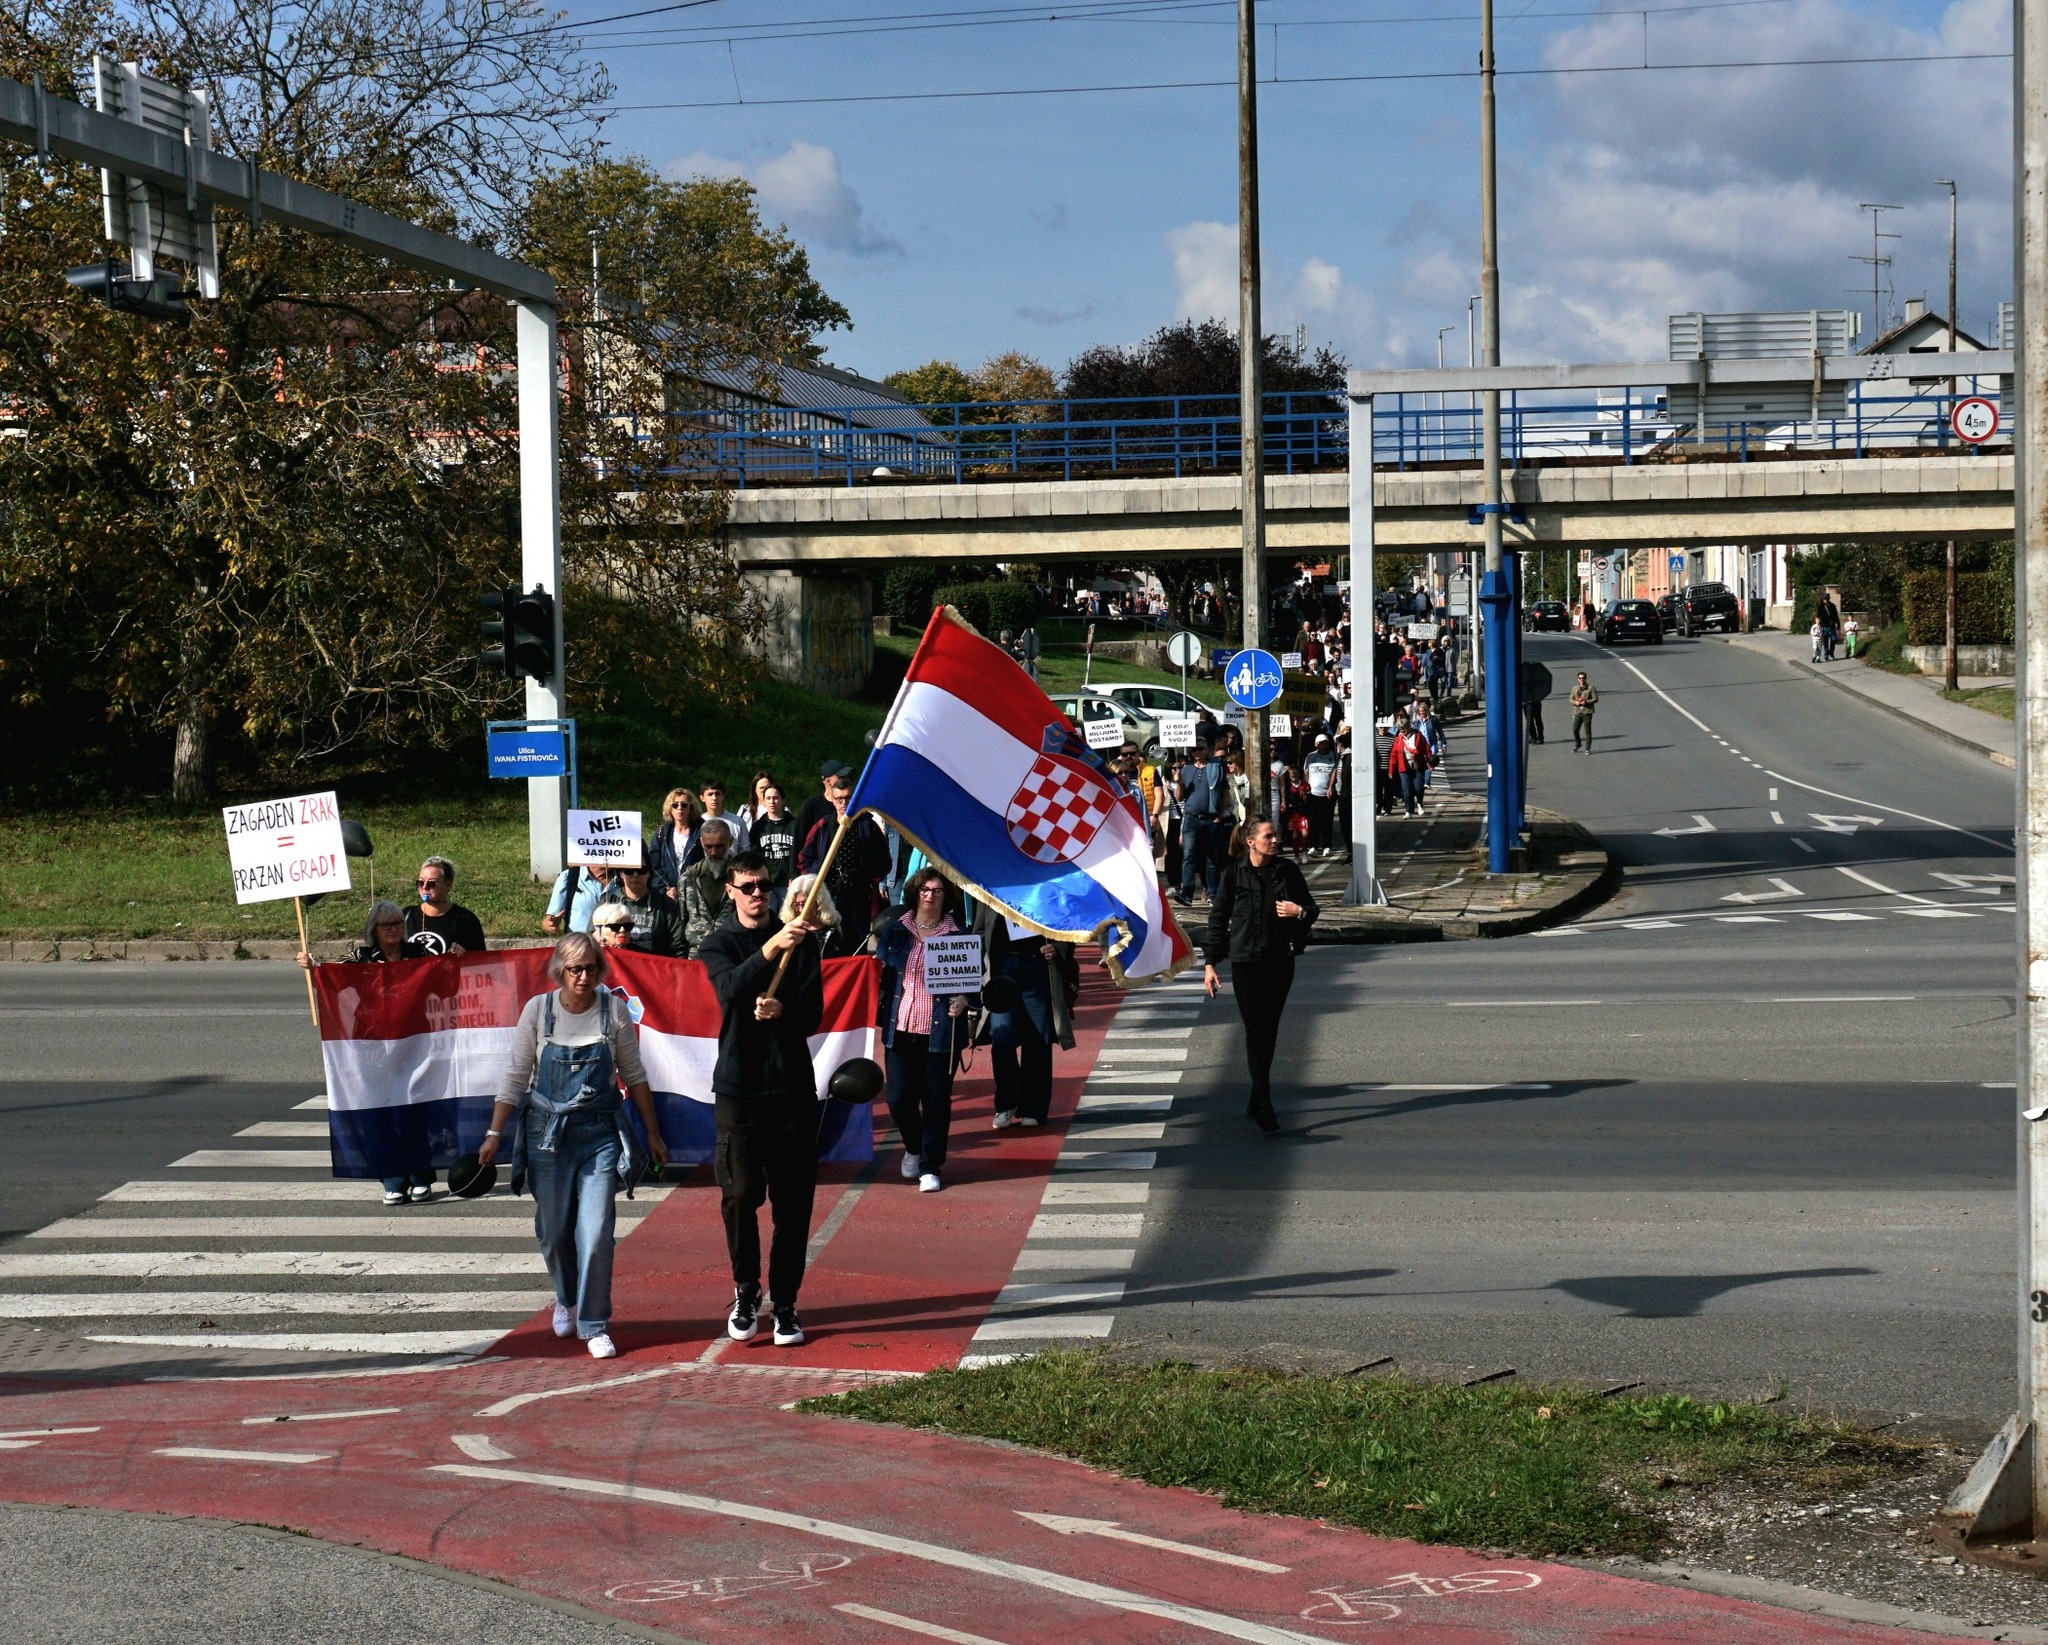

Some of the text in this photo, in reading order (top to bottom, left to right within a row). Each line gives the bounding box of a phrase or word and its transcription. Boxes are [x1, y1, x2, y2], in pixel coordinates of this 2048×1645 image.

[1965, 413, 1987, 428] 4,5m
[1089, 729, 1119, 737] MILIJUNA
[494, 755, 517, 763] IVANA
[299, 796, 338, 825] ZRAK
[588, 815, 622, 834] NE!
[577, 838, 631, 847] GLASNO I
[583, 849, 625, 858] JASNO!
[234, 854, 336, 892] PRAZAN GRAD!
[927, 940, 980, 952] NAŠI MRTVI
[937, 953, 968, 964] DANAS
[928, 965, 980, 976] SU S NAMA!
[475, 972, 494, 989] DA
